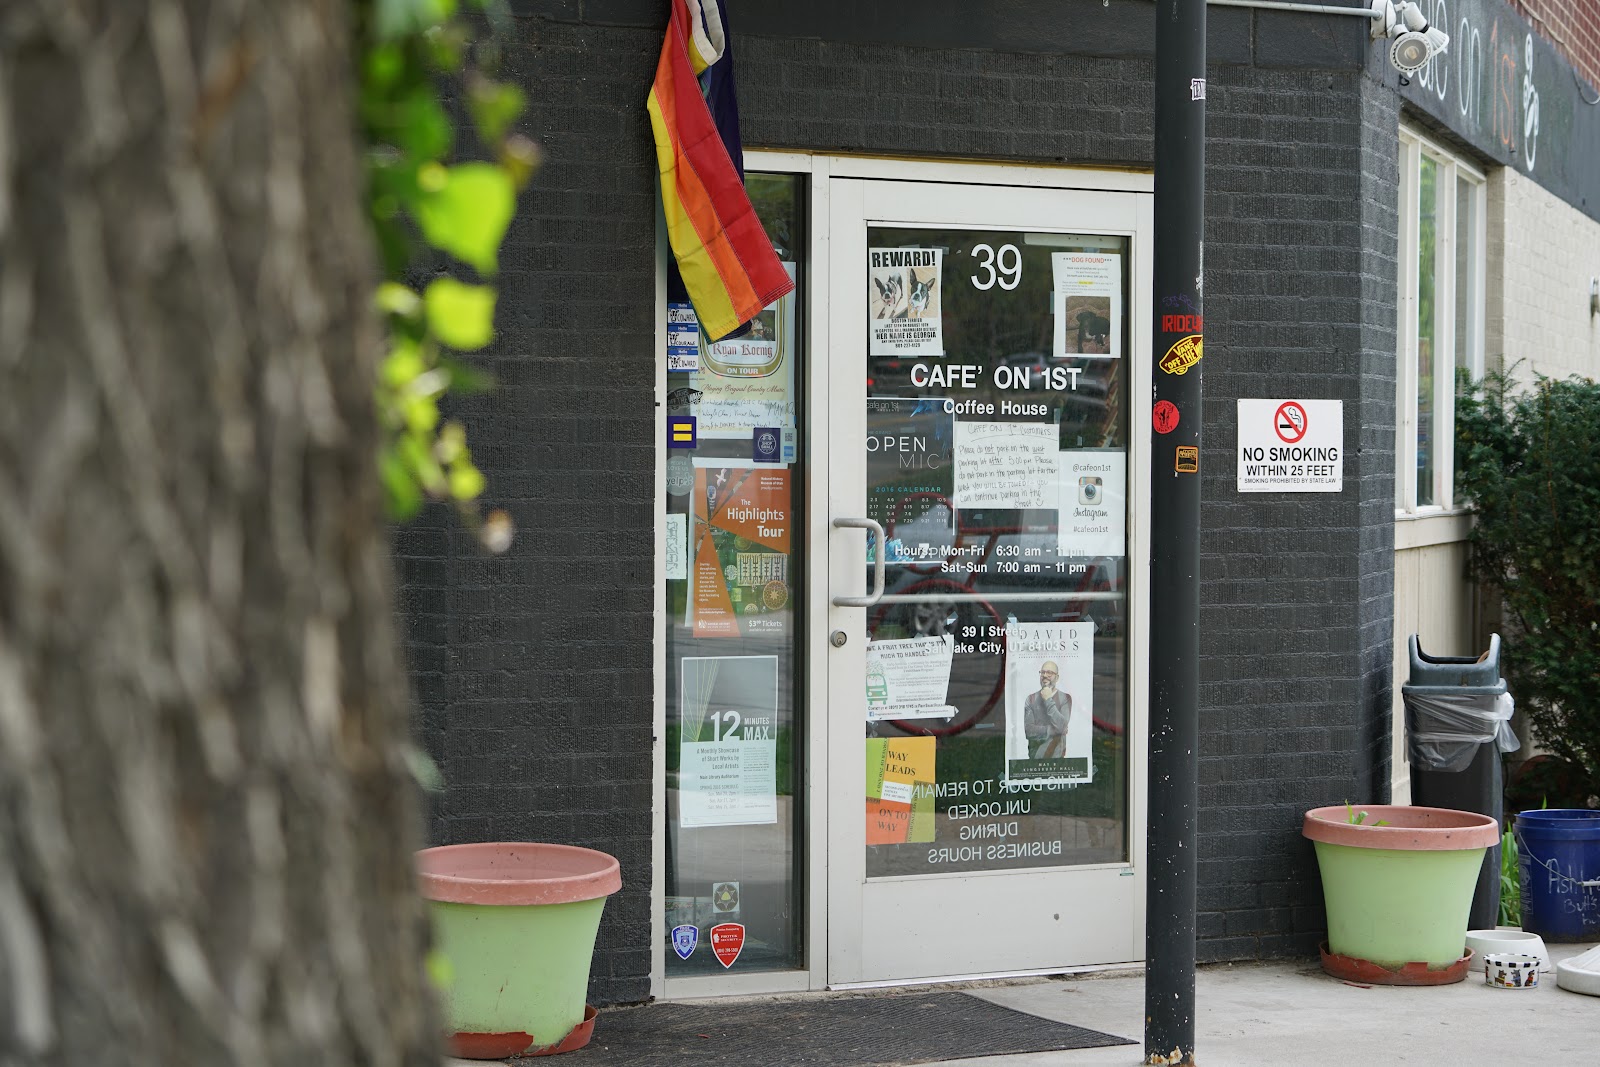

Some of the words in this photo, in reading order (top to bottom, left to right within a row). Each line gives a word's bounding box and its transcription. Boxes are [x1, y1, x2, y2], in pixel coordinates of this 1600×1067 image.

[872, 251, 936, 267] REWARD!
[971, 243, 1023, 291] 39
[712, 344, 737, 357] Ryan
[1173, 338, 1195, 356] VANS
[993, 365, 1030, 390] ON
[1041, 366, 1082, 391] 1ST
[943, 400, 995, 415] Coffee
[1001, 401, 1047, 415] House
[866, 436, 926, 452] OPEN
[985, 444, 995, 453] not
[1020, 444, 1029, 452] the
[900, 453, 940, 470] MIC
[1243, 447, 1265, 462] NO
[1269, 447, 1338, 462] SMOKING
[1073, 464, 1111, 472] @cafeon1st
[1246, 465, 1287, 476] WITHIN
[1291, 465, 1304, 476] 25
[1307, 465, 1335, 476] FEET
[727, 508, 784, 523] Highlights
[1073, 507, 1108, 521] Instagram
[757, 525, 784, 537] Tour
[941, 545, 985, 556] Mon-Fri
[996, 545, 1020, 556] 6:30
[1024, 547, 1041, 556] am
[941, 561, 988, 573] Sat-Sun
[996, 561, 1019, 573] 7:00
[1023, 563, 1041, 573] am
[1055, 562, 1065, 572] 11
[1069, 564, 1086, 575] pm
[962, 626, 977, 638] 39
[980, 626, 984, 637] I
[988, 626, 1023, 638] Street
[1020, 629, 1078, 640] DAVID
[978, 642, 1005, 655] City,
[1029, 640, 1059, 652] 84103
[711, 711, 740, 741] 12
[744, 717, 769, 725] MINUTES
[744, 726, 769, 740] MAX
[888, 751, 908, 761] WAY
[886, 764, 916, 776] LEADS
[879, 808, 892, 817] ON
[895, 810, 907, 820] TO
[878, 821, 897, 832] WAY
